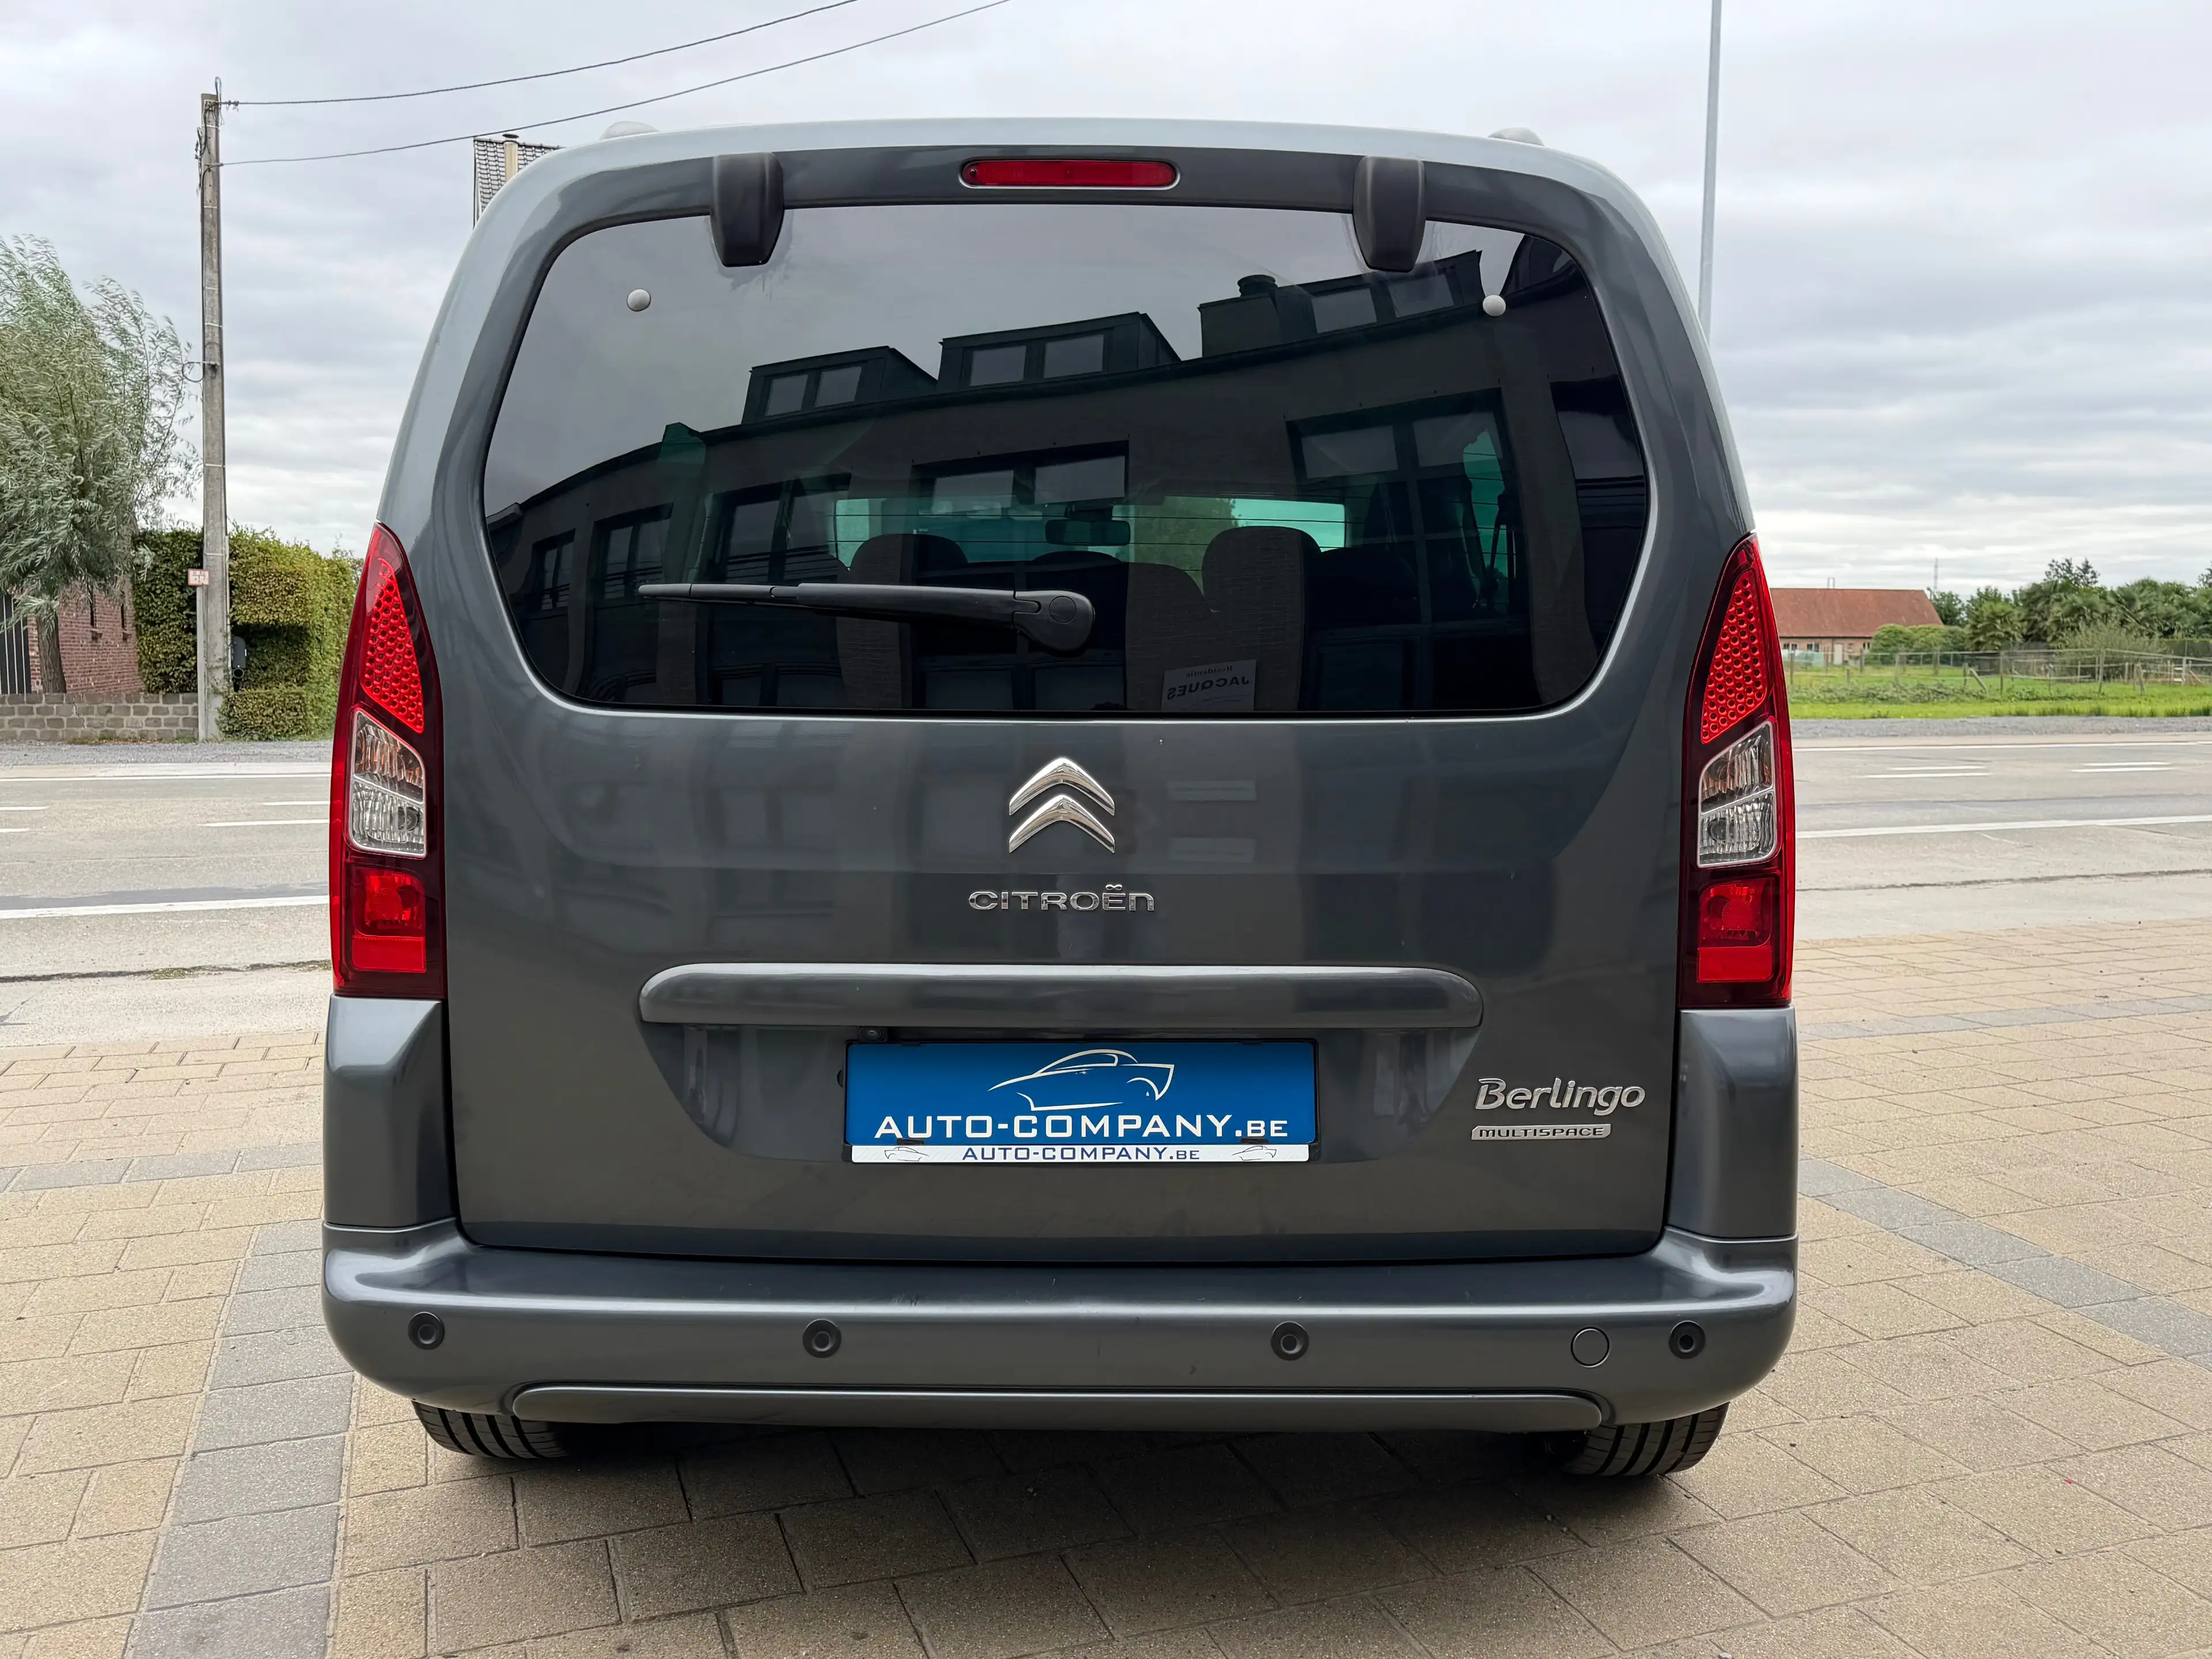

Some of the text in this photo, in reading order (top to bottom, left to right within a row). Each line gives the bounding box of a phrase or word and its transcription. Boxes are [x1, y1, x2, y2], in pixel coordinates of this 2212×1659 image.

[1475, 1077, 1646, 1116] Berlingo
[874, 1114, 1288, 1138] AUTO-COMPANY.BE
[1479, 1127, 1604, 1138] MULTISPACE
[962, 1146, 1200, 1161] AUTO-COMPANY.BE
